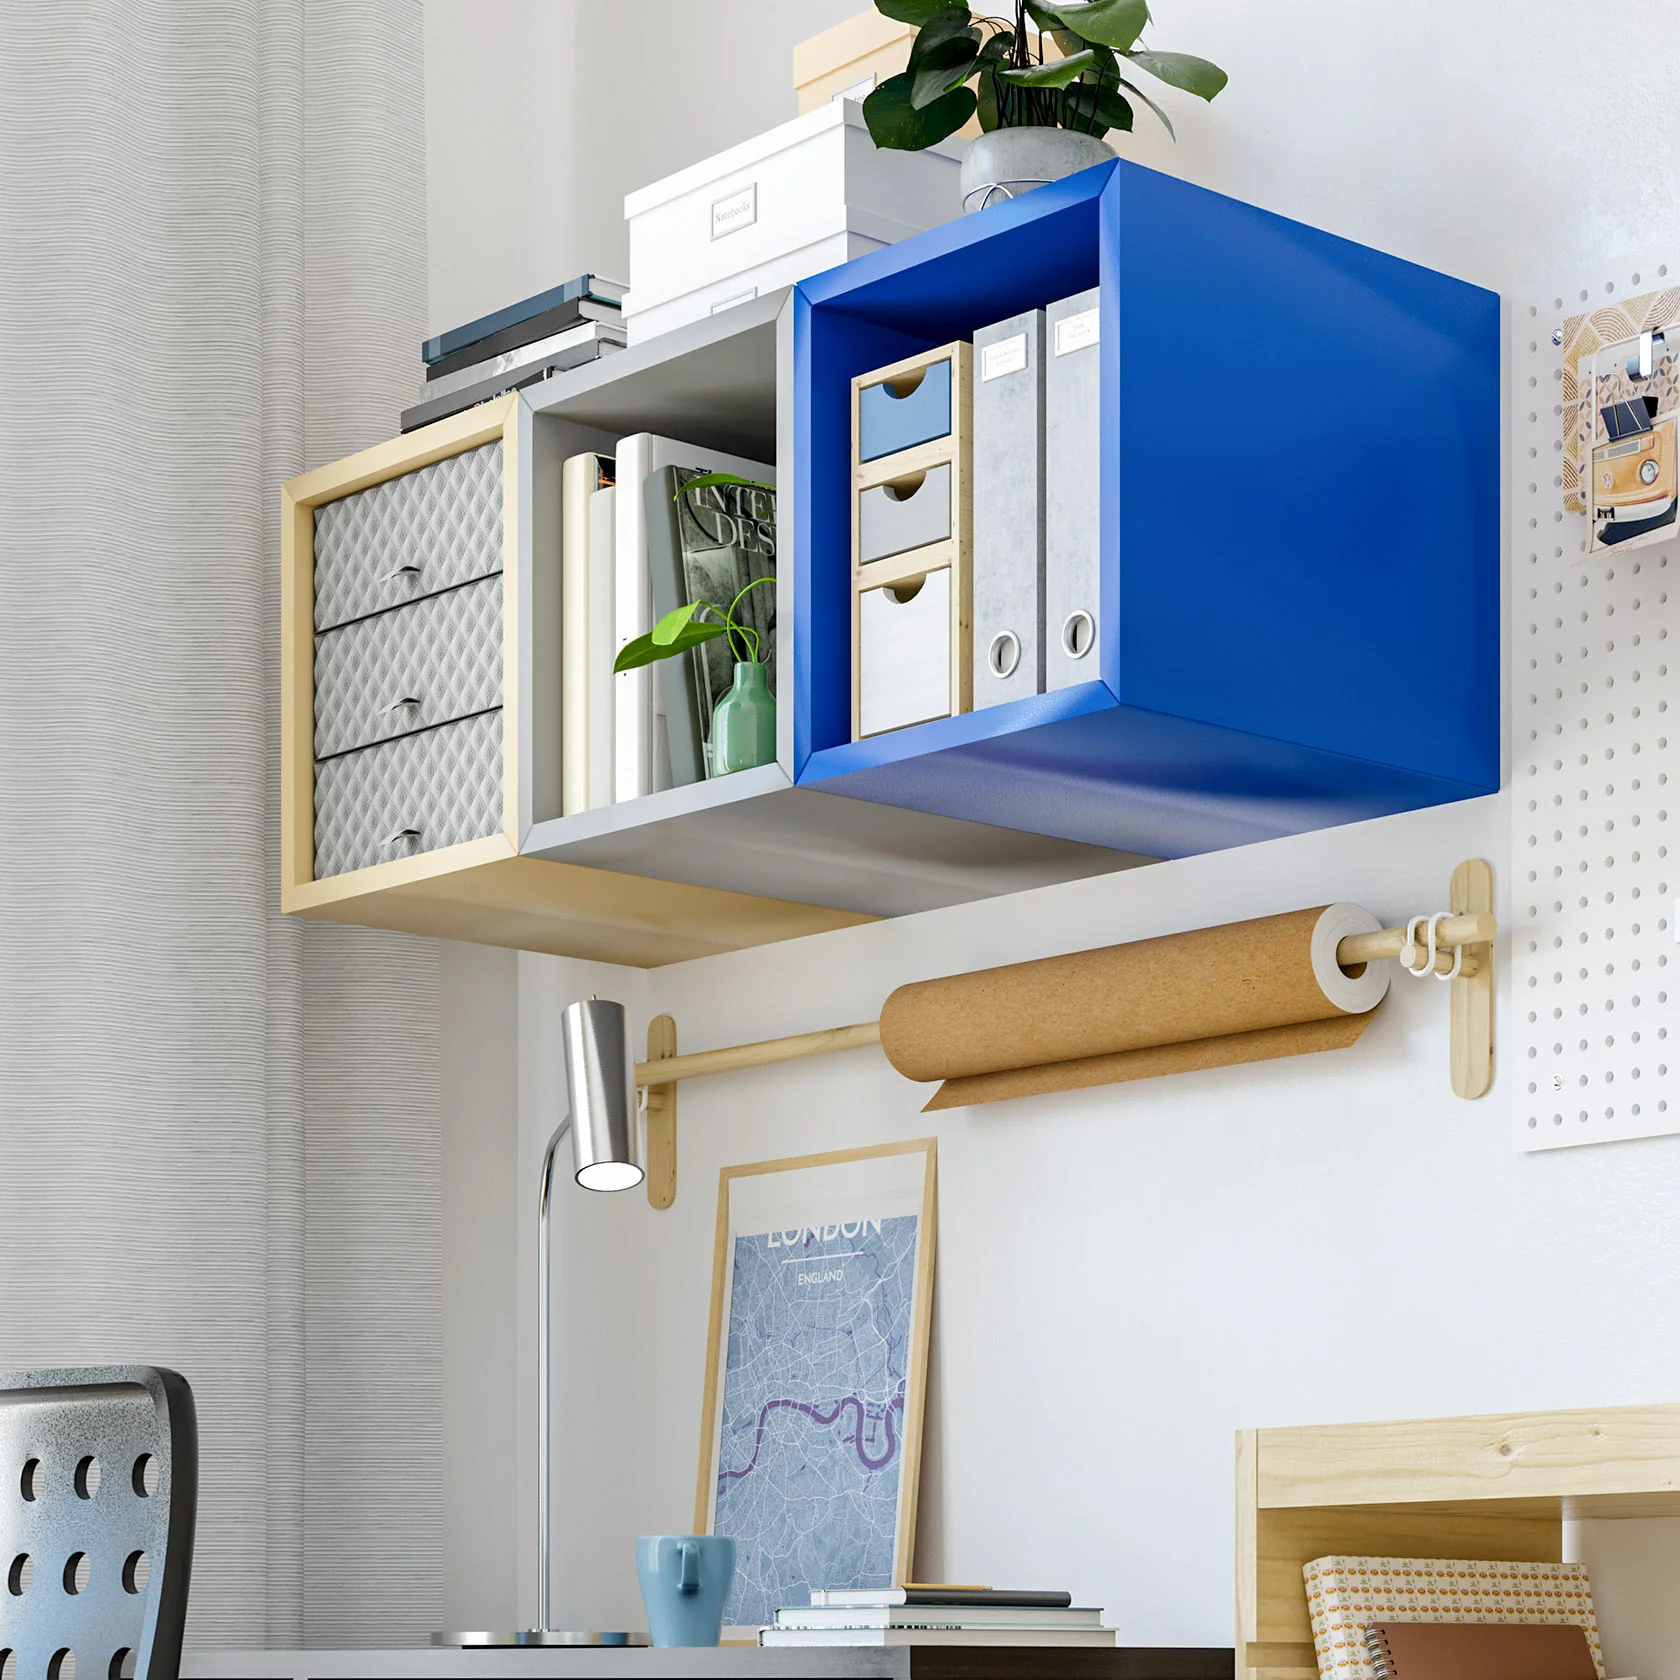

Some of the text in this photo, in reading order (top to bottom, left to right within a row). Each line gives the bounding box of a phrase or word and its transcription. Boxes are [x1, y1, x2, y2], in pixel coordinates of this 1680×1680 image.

[716, 202, 751, 224] Notebooks
[712, 511, 776, 556] DES
[798, 1269, 843, 1286] ENGLAND
